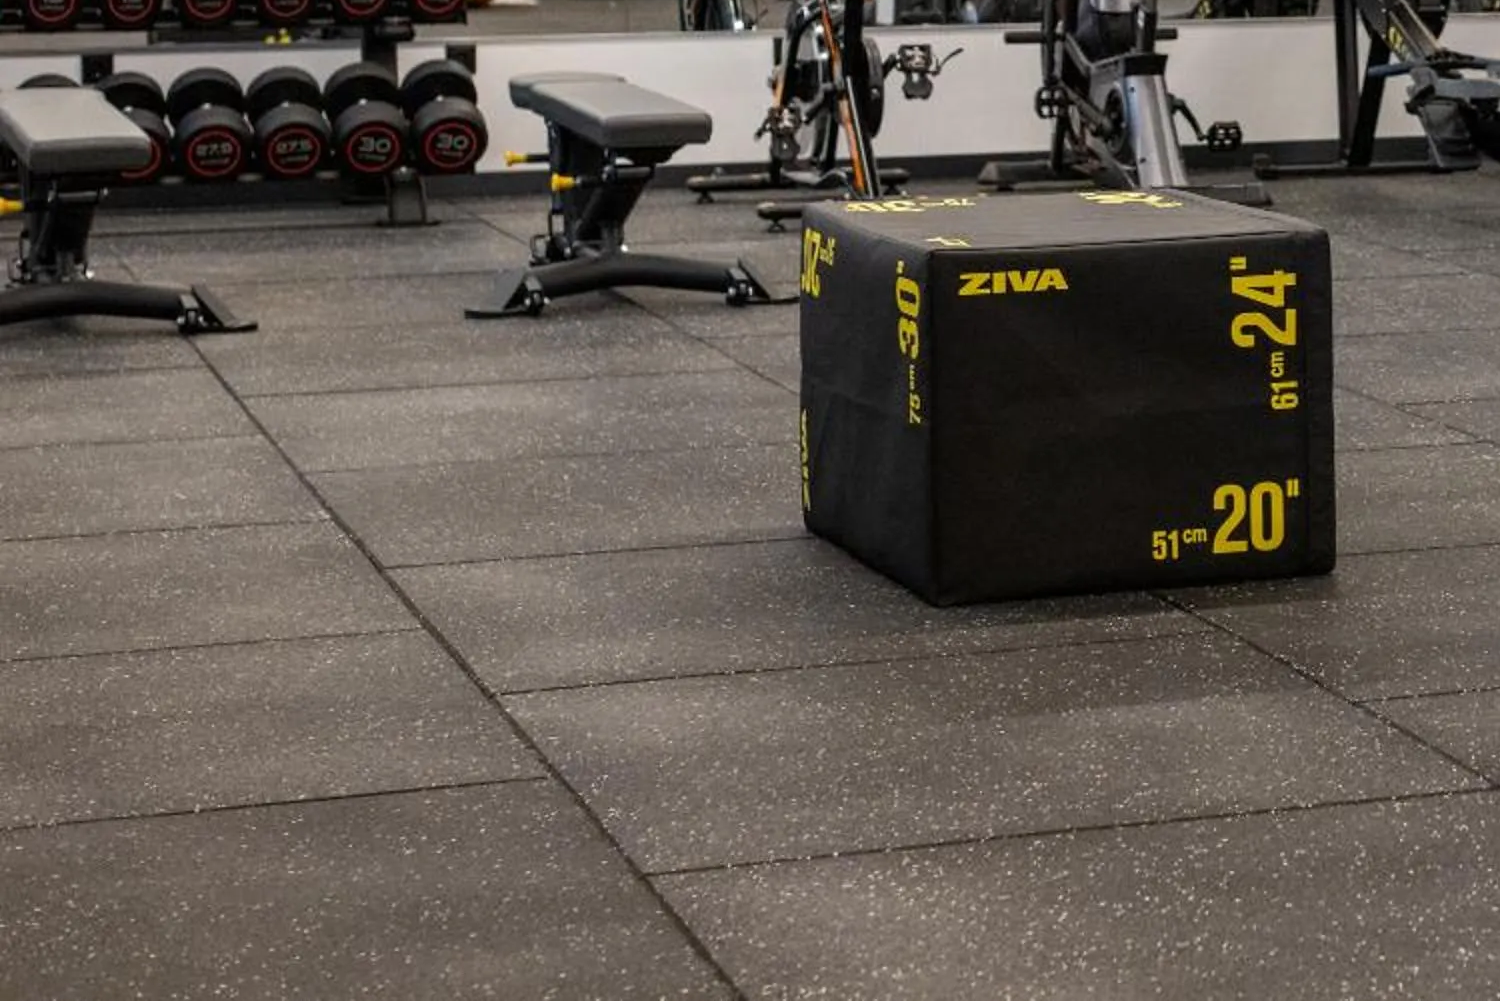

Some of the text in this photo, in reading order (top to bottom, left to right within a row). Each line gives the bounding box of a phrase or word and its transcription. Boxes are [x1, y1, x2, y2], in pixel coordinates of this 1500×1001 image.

[957, 268, 1069, 297] ZIVA
[1229, 256, 1298, 348] 24"
[1211, 476, 1300, 555] 20"
